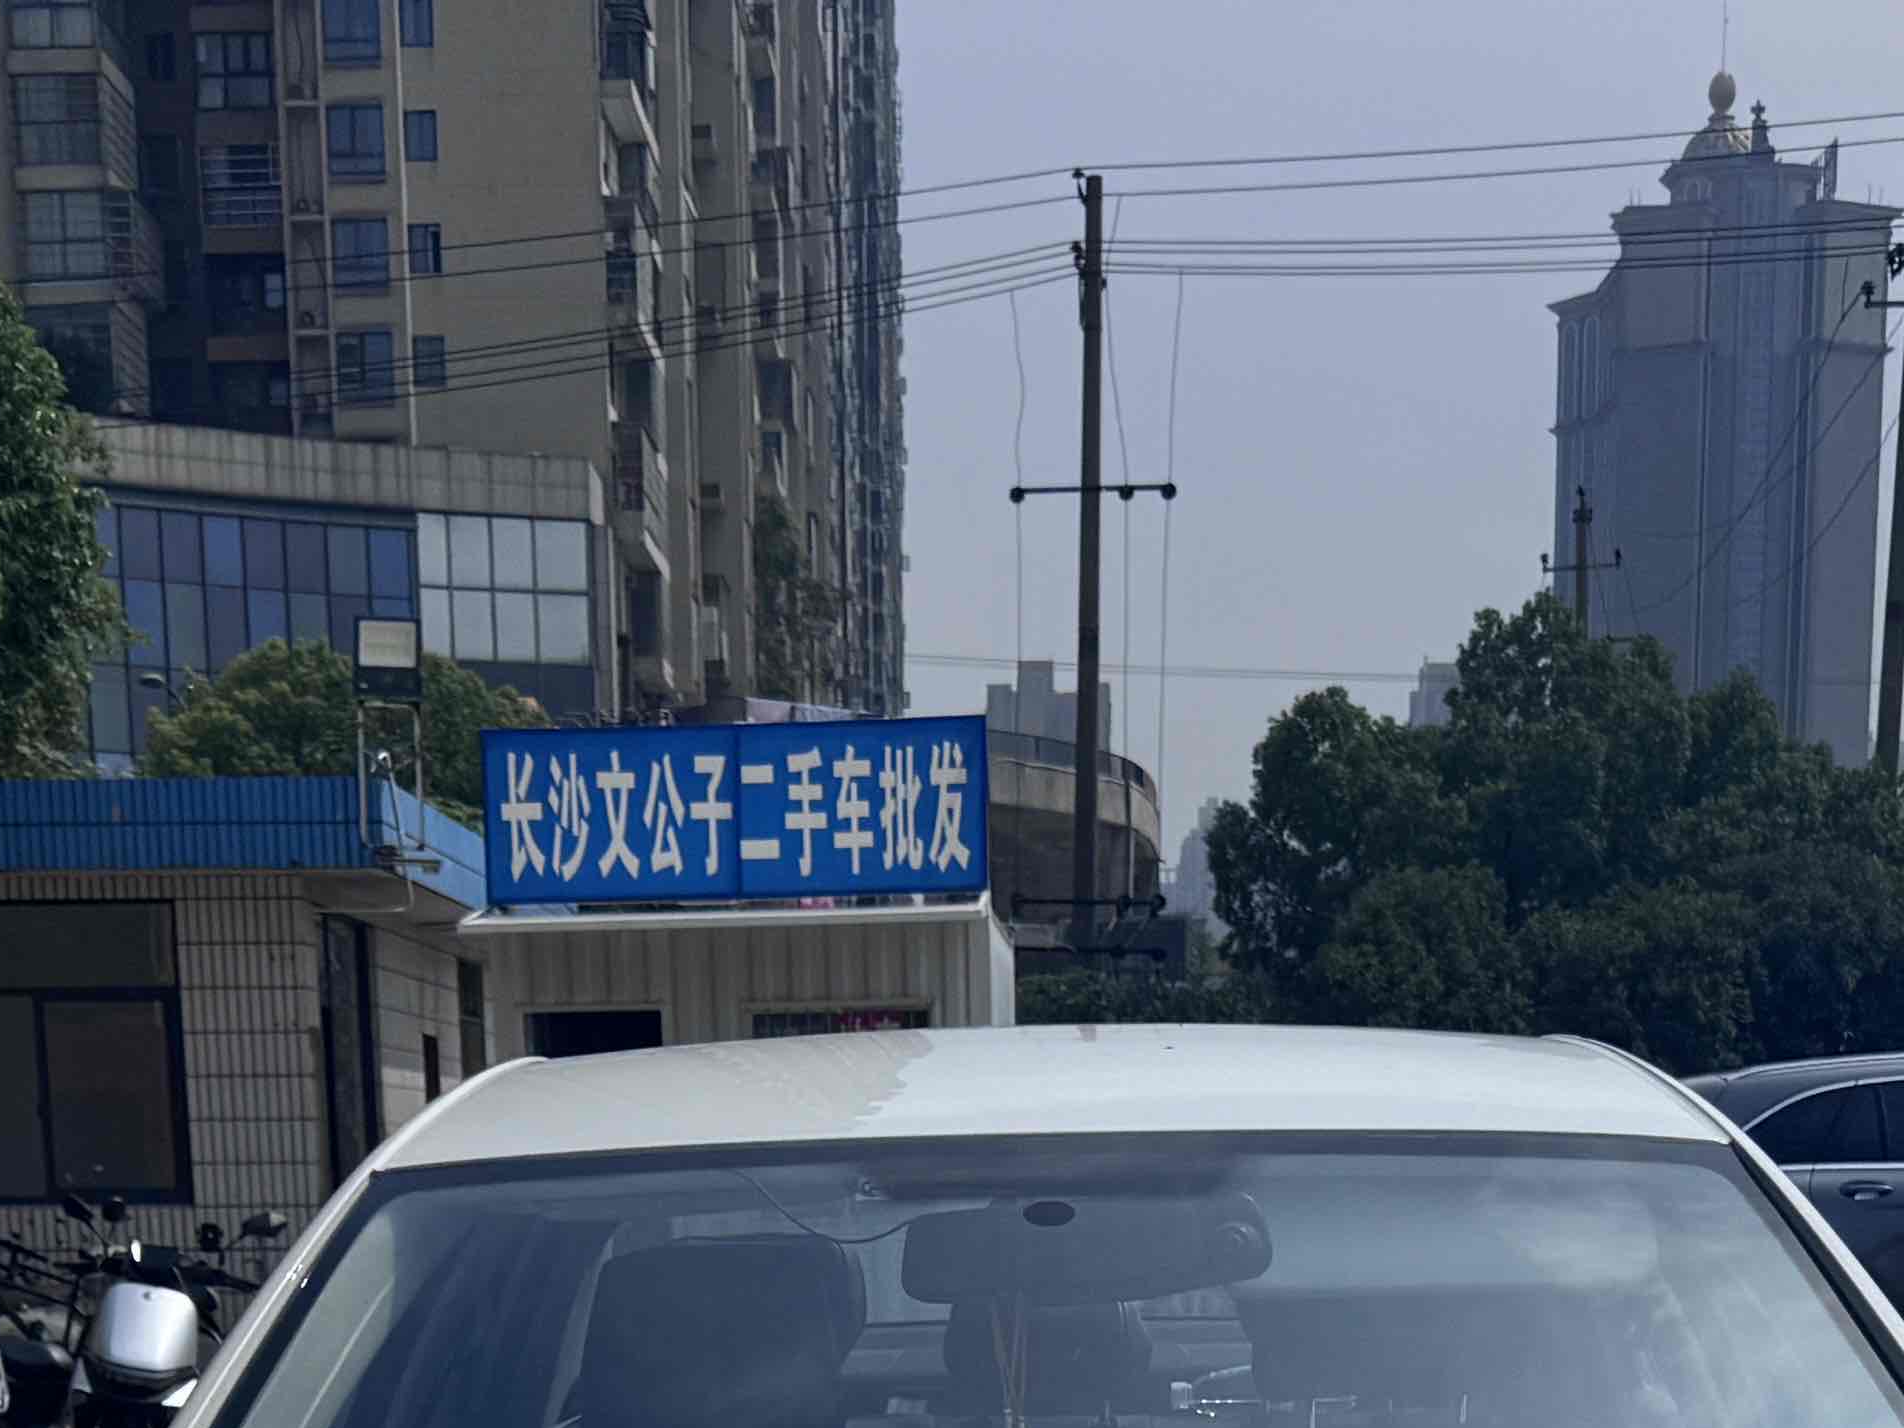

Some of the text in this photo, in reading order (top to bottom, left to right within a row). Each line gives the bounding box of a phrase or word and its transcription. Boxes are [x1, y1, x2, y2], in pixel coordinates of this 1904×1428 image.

[501, 740, 971, 883] 长沙文公子二手车批发
